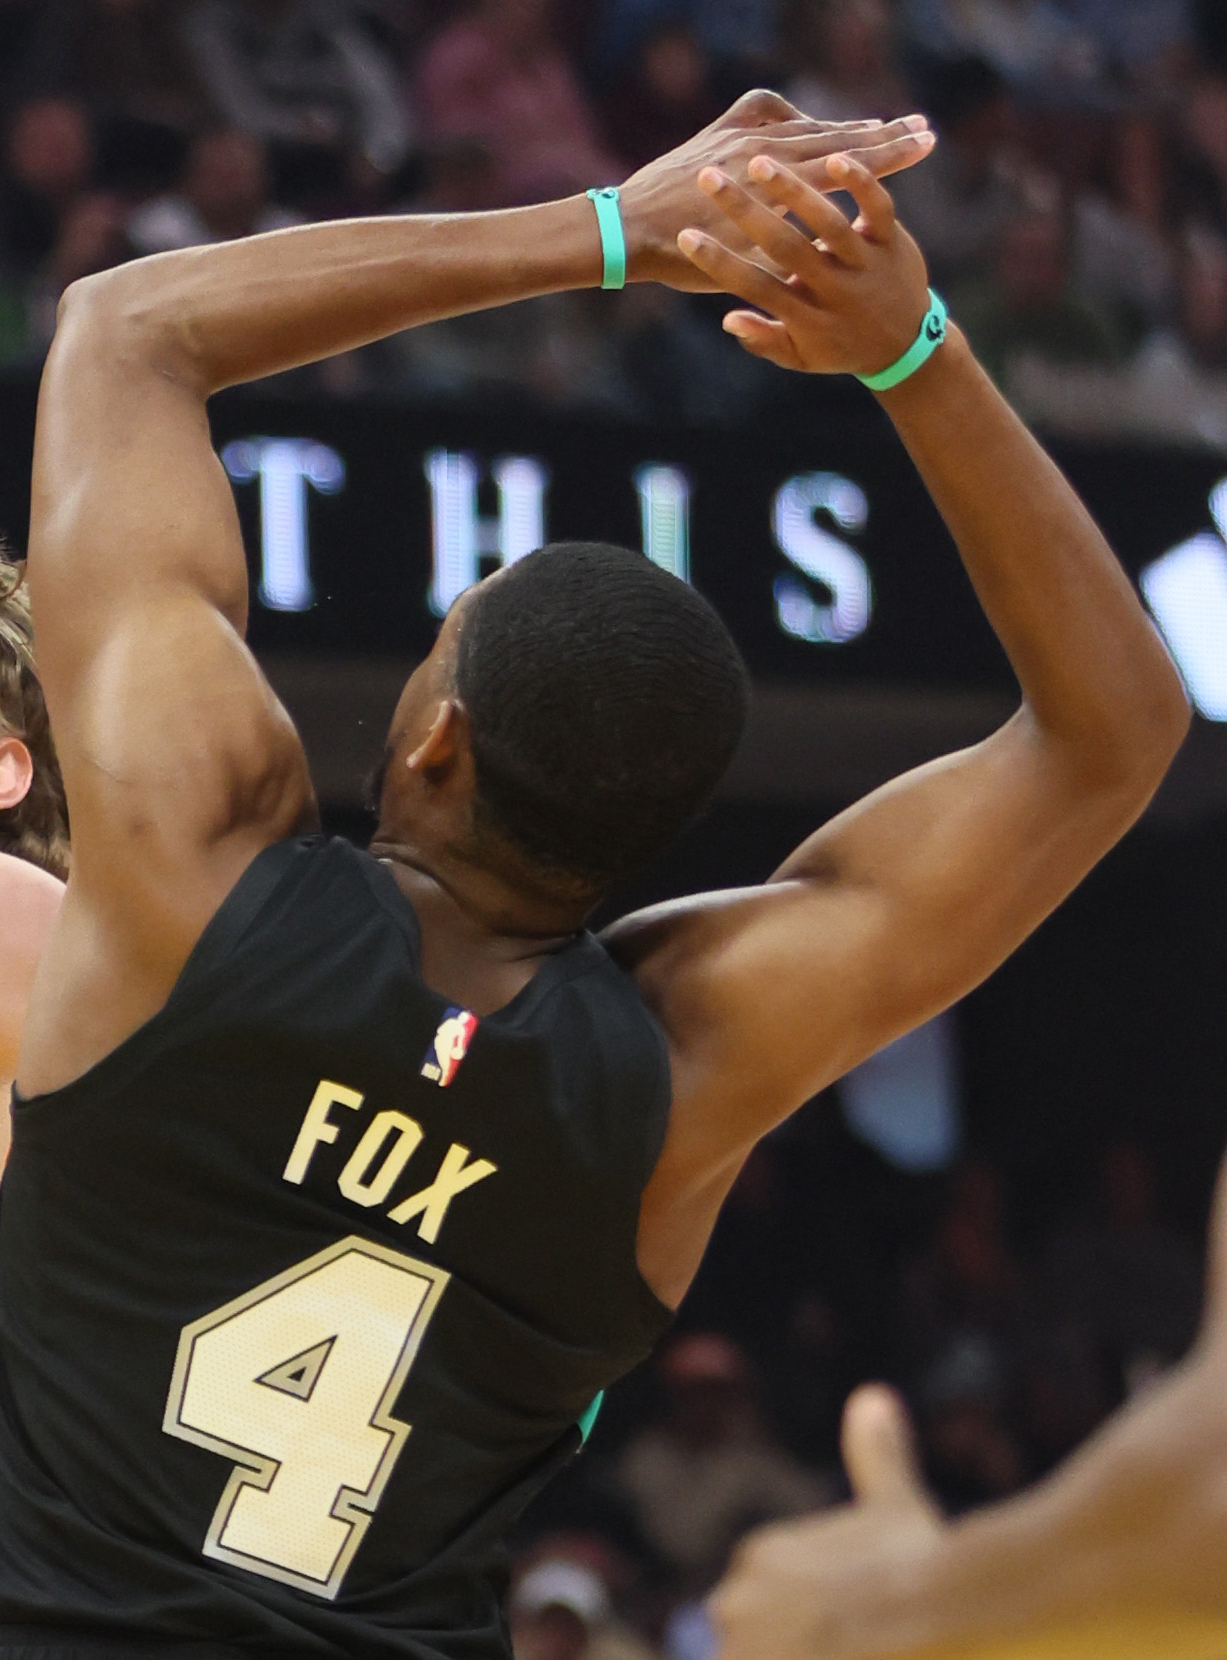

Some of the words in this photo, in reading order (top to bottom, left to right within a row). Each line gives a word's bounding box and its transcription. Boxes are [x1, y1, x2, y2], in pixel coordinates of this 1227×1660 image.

[221, 436, 872, 644] THIS
[281, 1078, 498, 1245] FOX
[162, 1234, 452, 1600] 4
